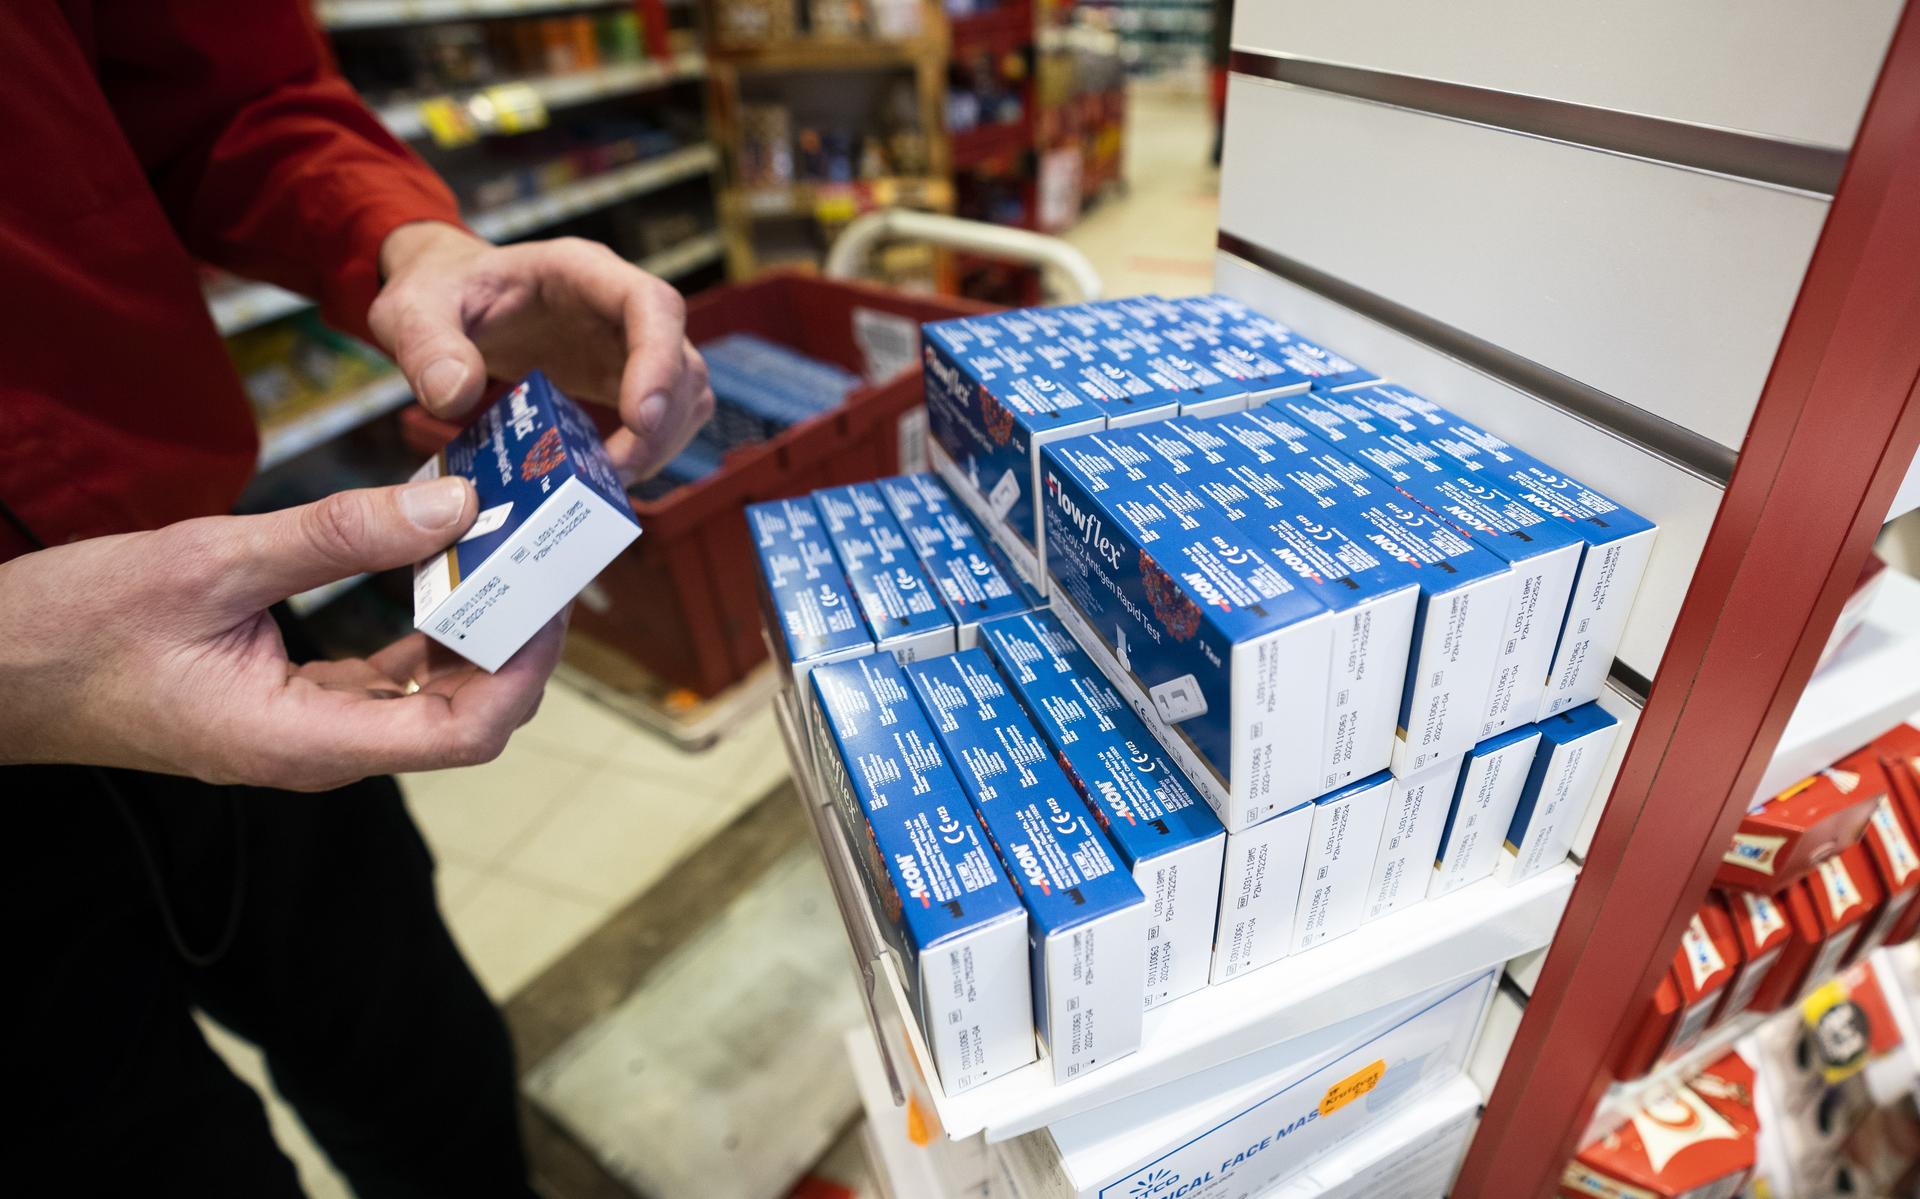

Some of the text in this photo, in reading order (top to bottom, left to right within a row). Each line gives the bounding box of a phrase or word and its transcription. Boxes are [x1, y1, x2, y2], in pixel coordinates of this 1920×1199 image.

[1049, 471, 1120, 570] Flowflex
[1445, 506, 1498, 536] ACON
[1273, 548, 1323, 584] ACON
[1368, 534, 1421, 568] ACON
[1085, 551, 1115, 594] Antigen
[1117, 586, 1140, 622] Rapid
[1142, 613, 1161, 644] Test
[1181, 573, 1232, 612] ACON
[1513, 577, 1533, 633] L031-118M5
[1521, 575, 1542, 640] PZN-17522524
[1450, 594, 1469, 662] PZN-17522524
[1559, 642, 1582, 690] COV1110063
[1567, 639, 1589, 687] 2023-11-04
[1489, 667, 1509, 716] COV1110063
[1500, 664, 1519, 713] 2023-11-04
[1332, 714, 1347, 765] COV1110063
[1343, 710, 1358, 761] 2023-11-04
[1422, 695, 1440, 745] COV1110063
[1432, 692, 1449, 742] 2023-11-04
[813, 702, 858, 824] Flowflex
[1125, 741, 1140, 755] 0123
[1261, 743, 1272, 795] 2023-11-04
[937, 806, 950, 823] 0123
[1047, 798, 1061, 814] 0123
[1096, 781, 1136, 826] ACON
[1405, 785, 1424, 839] PZN-17522524
[1332, 804, 1350, 861] PZN-17522524
[896, 854, 930, 908] ACON
[1011, 844, 1051, 896] ACON
[1154, 869, 1165, 917] L031-118M5
[1165, 865, 1177, 922] PZN-17522524
[1242, 847, 1256, 895] L031-118M5
[1252, 843, 1268, 899] PZN-17522524
[1220, 1136, 1273, 1174] FACE
[1276, 1107, 1322, 1142] MAS
